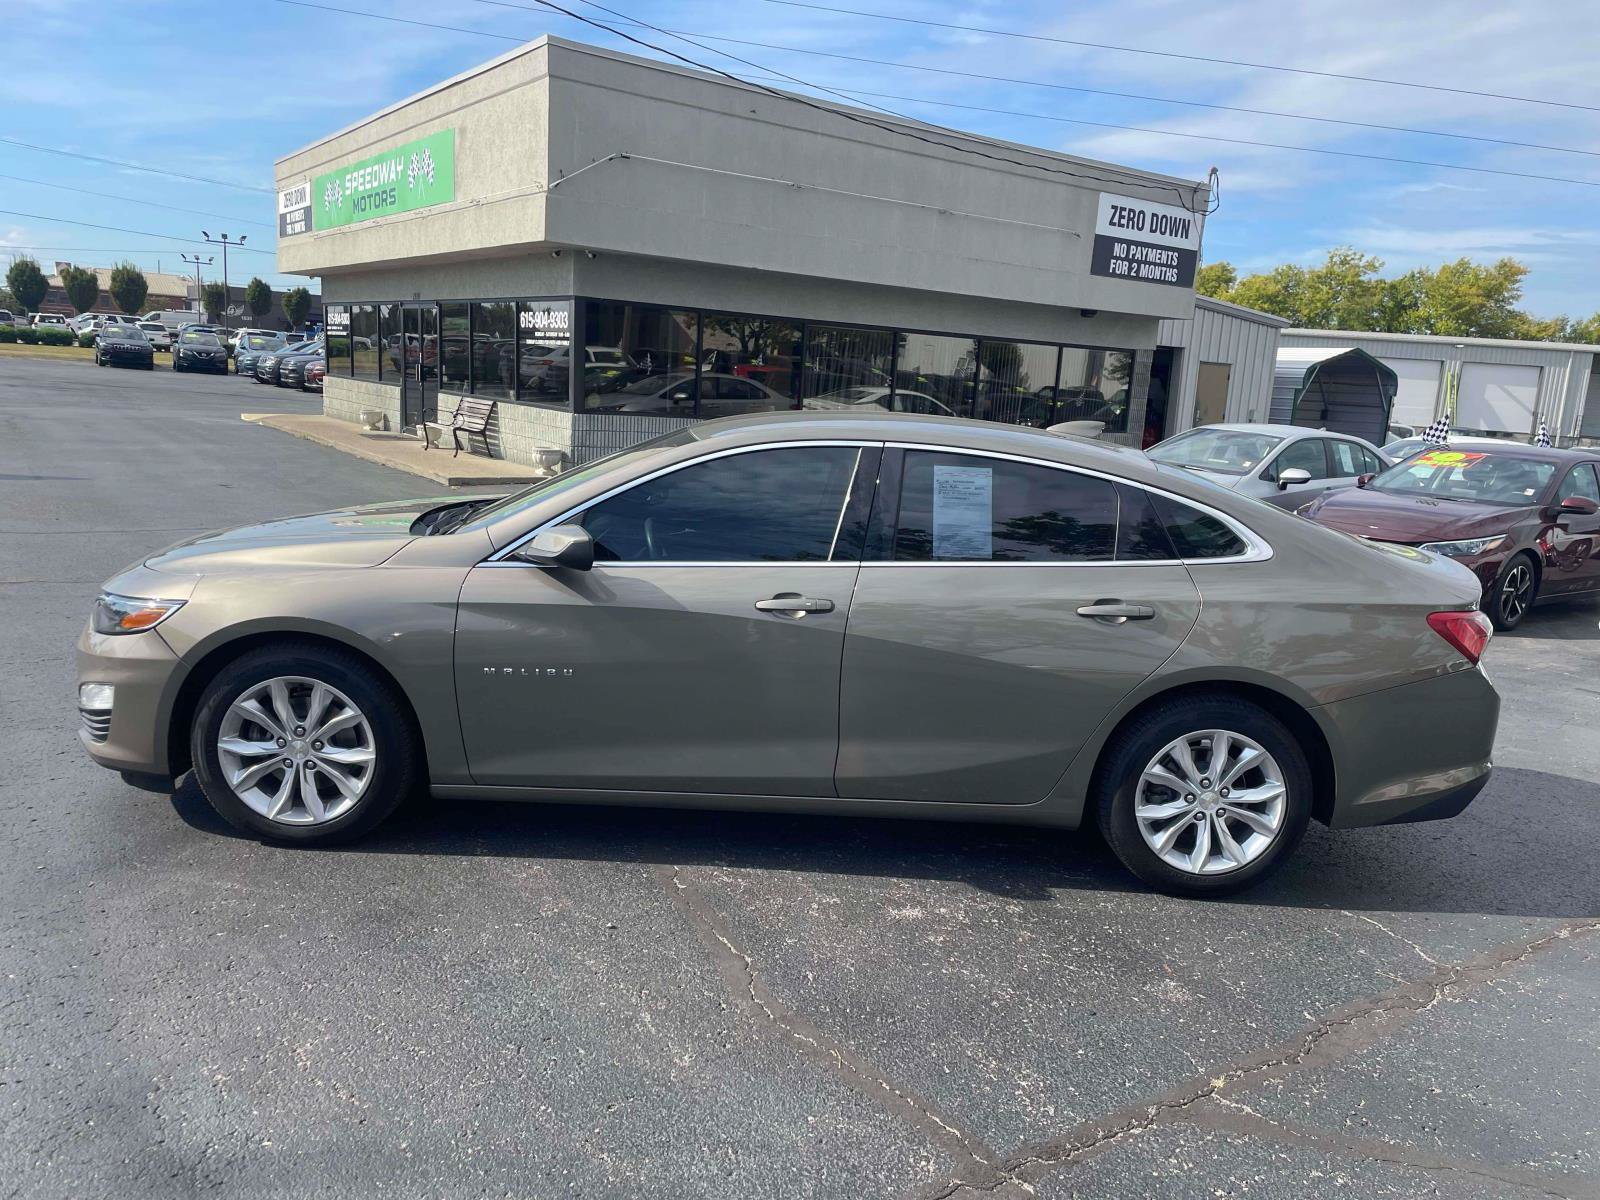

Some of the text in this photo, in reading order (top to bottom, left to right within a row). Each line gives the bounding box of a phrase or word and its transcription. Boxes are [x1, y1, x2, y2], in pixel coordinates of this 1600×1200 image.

[345, 156, 404, 195] SPEEDWAY
[353, 188, 397, 214] MOTORS
[1109, 205, 1191, 239] ZERO DOWN
[1113, 242, 1178, 266] NO PAYMENTS
[1109, 259, 1178, 283] FOR 2 MONTHS
[520, 311, 568, 328] 615-904-9303
[483, 667, 573, 676] MALIBU
